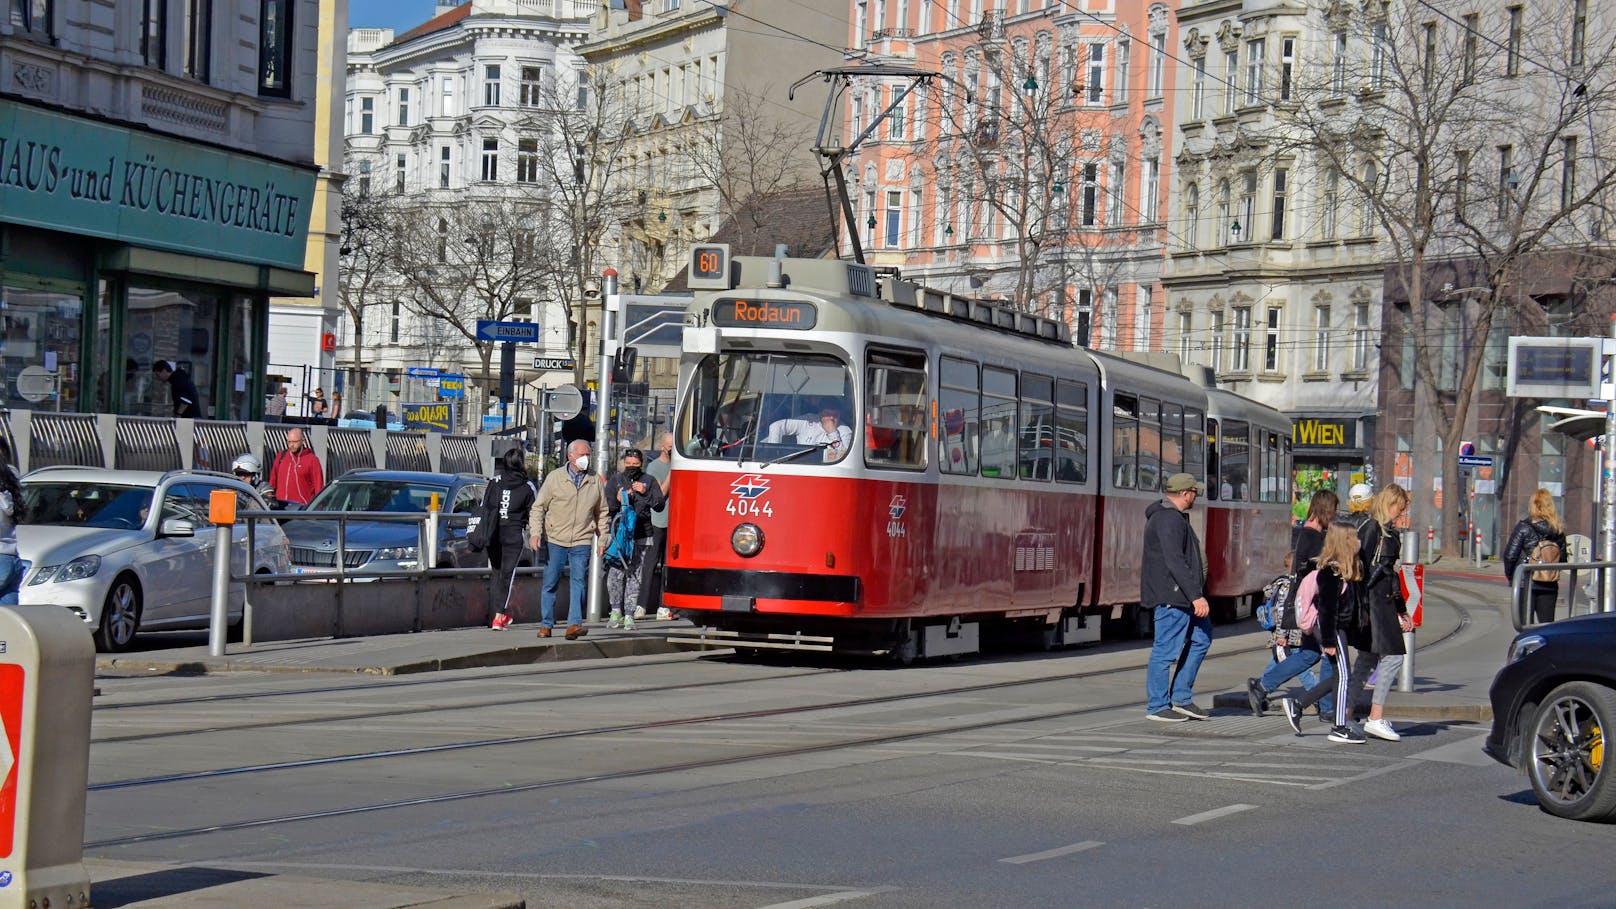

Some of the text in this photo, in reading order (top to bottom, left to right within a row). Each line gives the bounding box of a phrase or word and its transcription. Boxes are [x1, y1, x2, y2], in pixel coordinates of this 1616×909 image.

[119, 154, 299, 237] KÜCHENGERÄTE
[700, 252, 718, 273] 60
[734, 300, 801, 323] Rodaun
[497, 326, 532, 337] EINBAHN
[534, 358, 562, 369] DRUCK
[1299, 419, 1345, 445] WIEN
[725, 498, 774, 518] 4044
[886, 520, 906, 538] 4044
